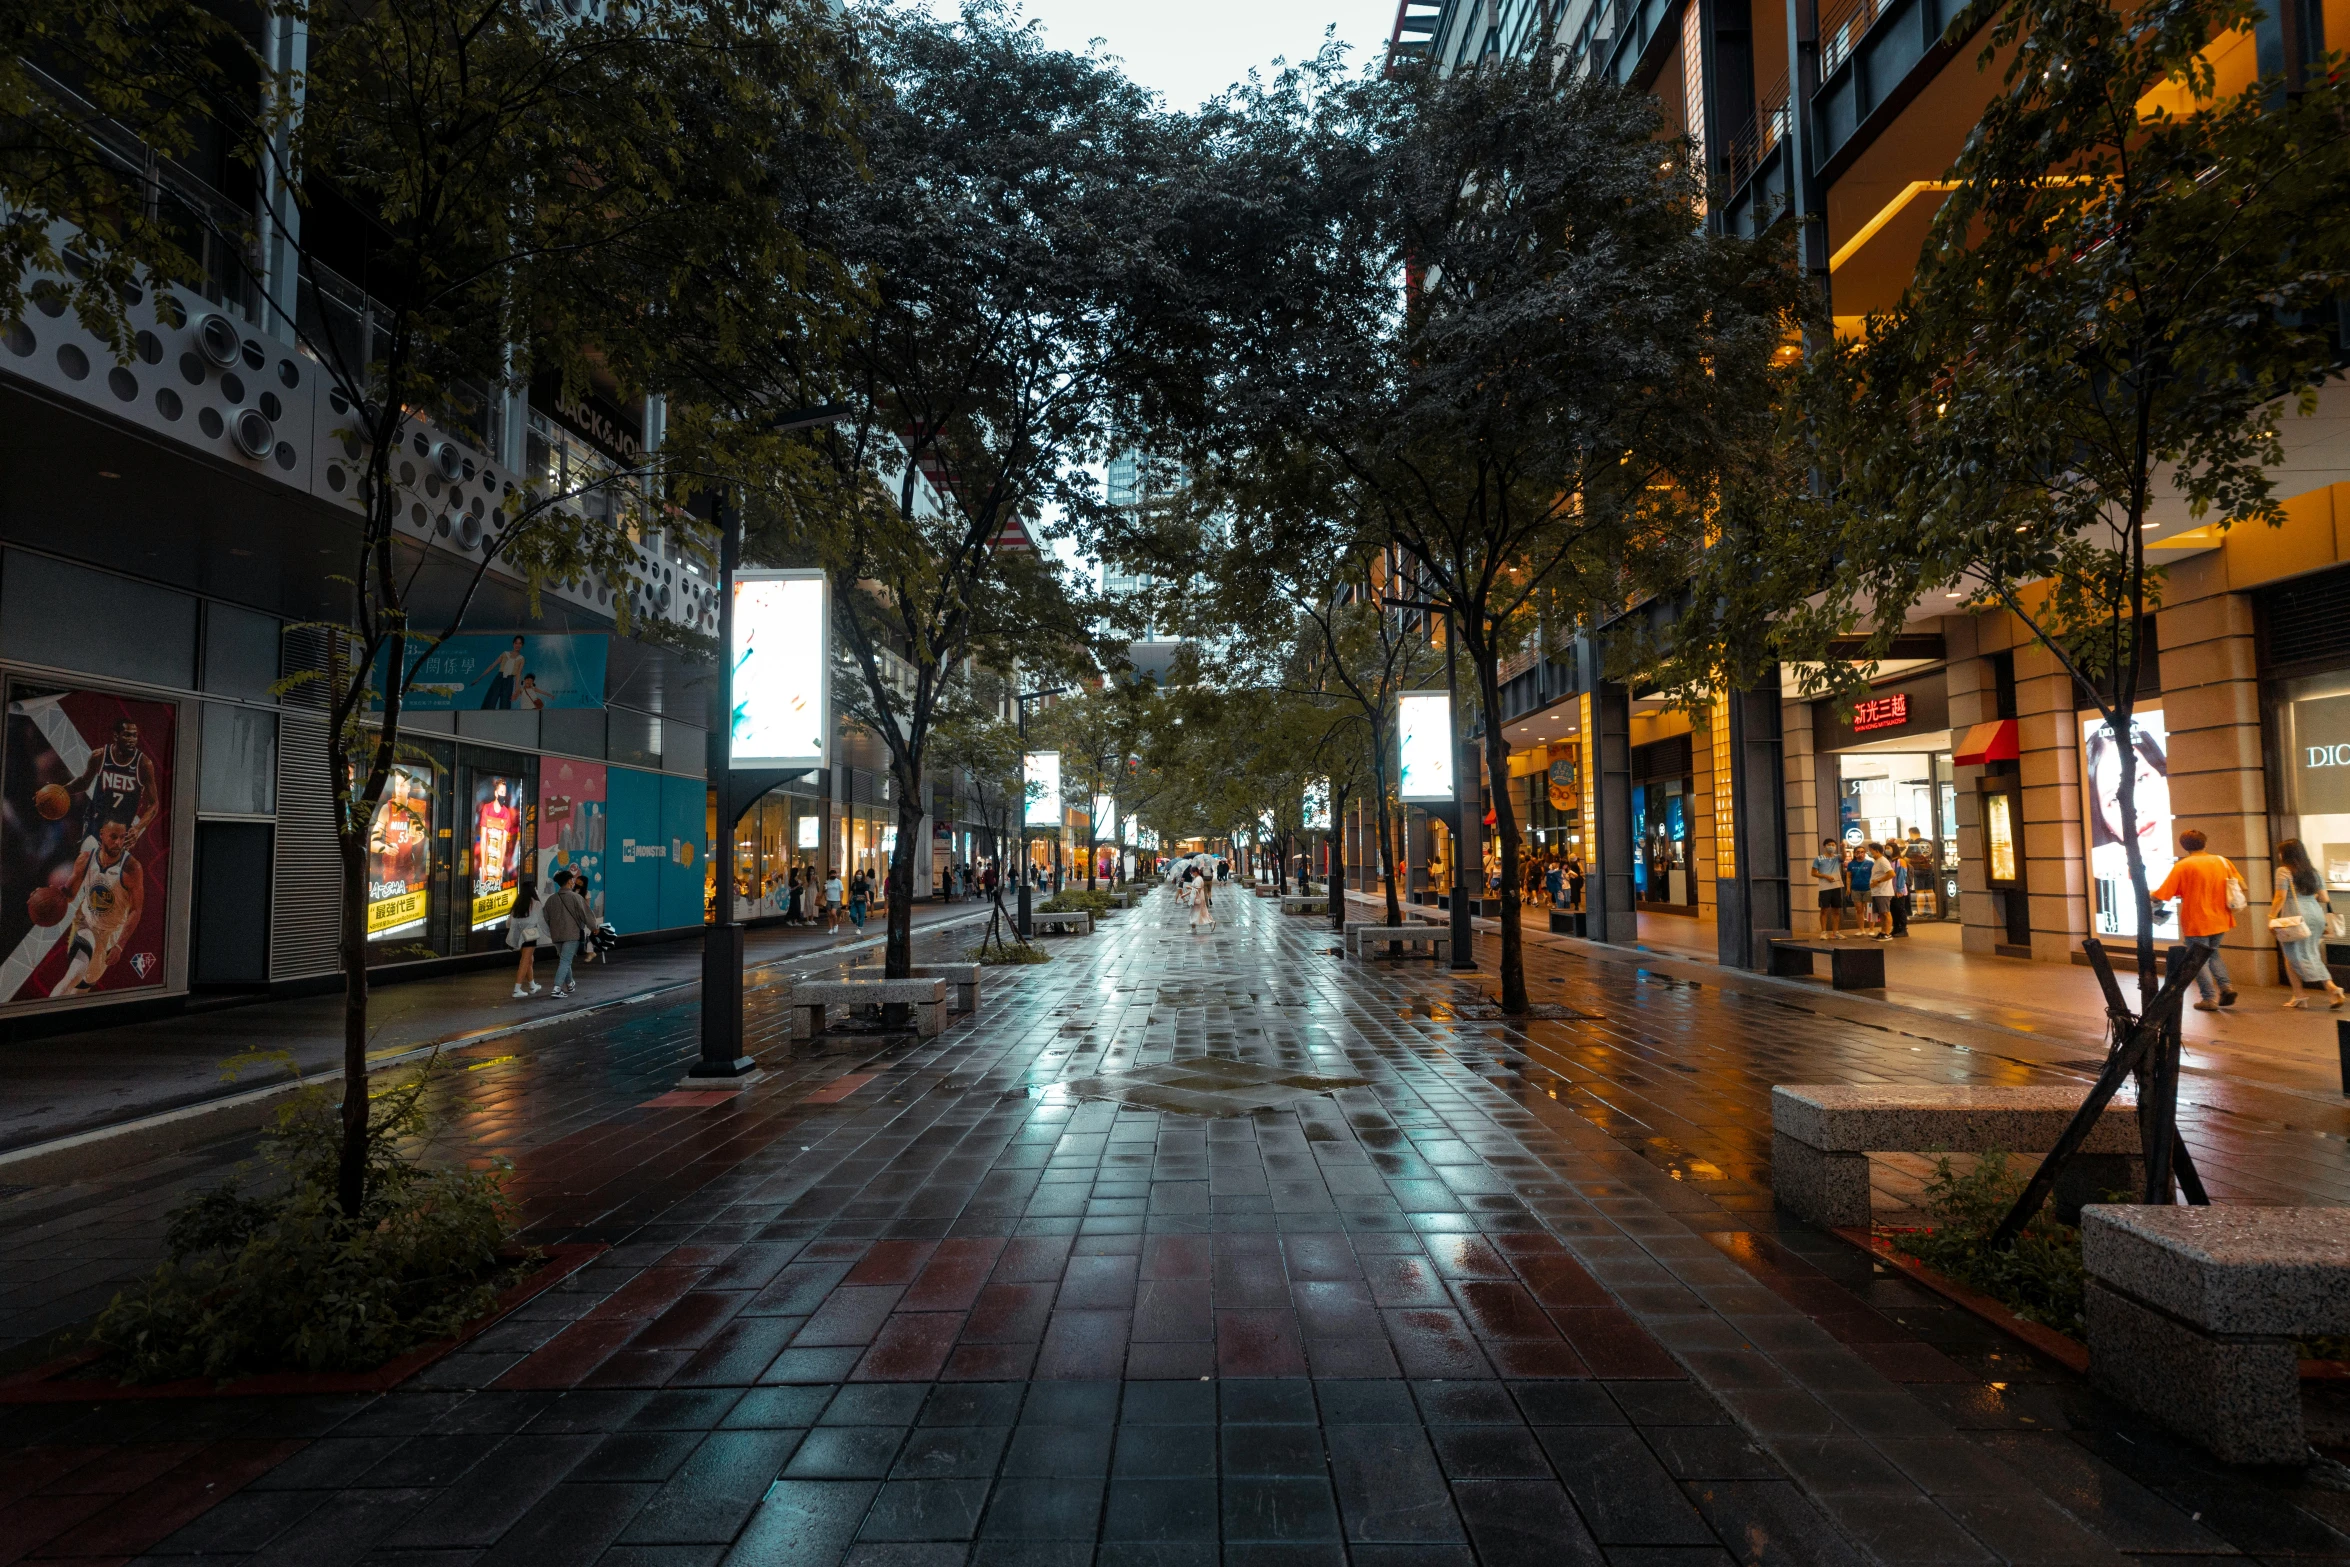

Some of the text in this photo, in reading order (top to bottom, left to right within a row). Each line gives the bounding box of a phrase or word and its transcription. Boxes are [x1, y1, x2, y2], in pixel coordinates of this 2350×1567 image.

[1854, 693, 1906, 725] 新光三越
[102, 770, 136, 792] NETS
[112, 792, 124, 808] 7
[624, 845, 634, 857] ICE
[635, 845, 667, 858] MONSTER
[370, 880, 406, 899] A-SHA
[473, 879, 501, 895] A-SHA
